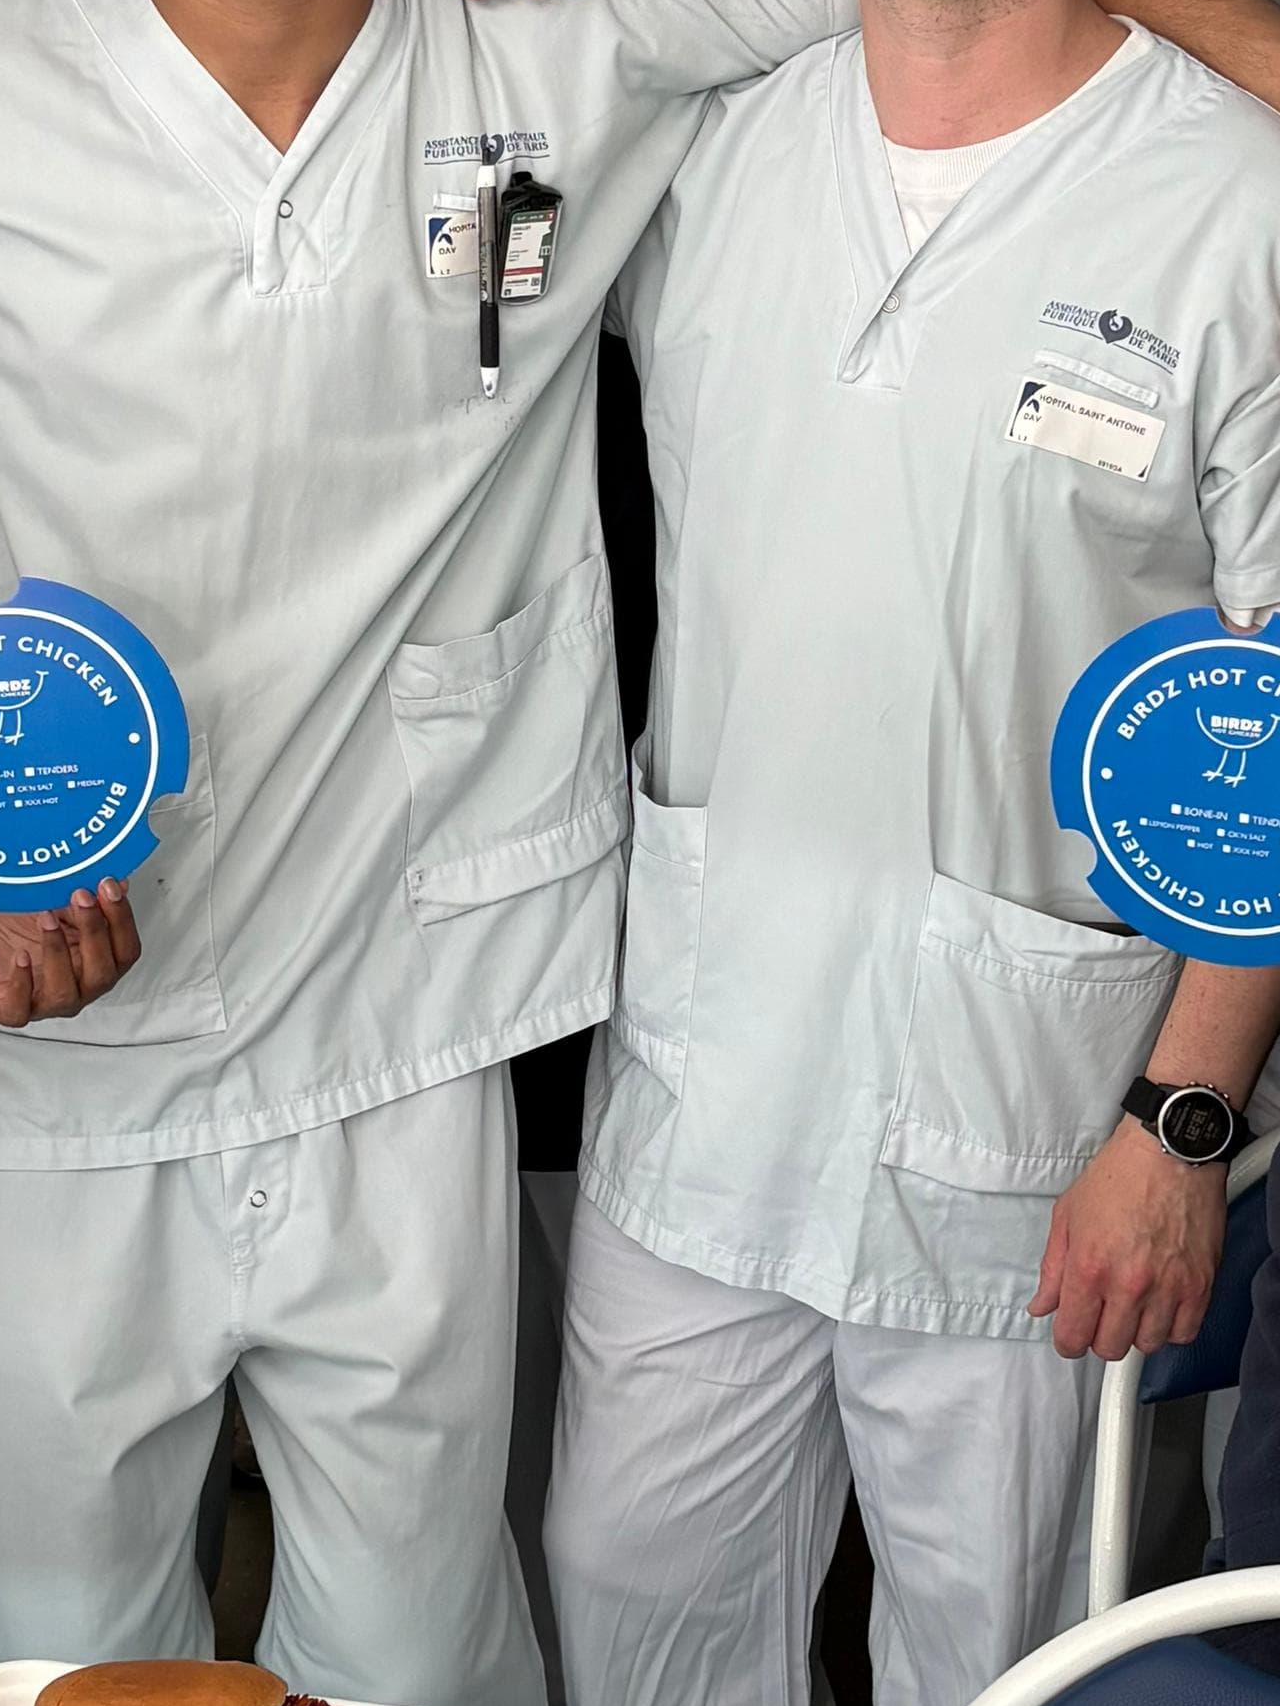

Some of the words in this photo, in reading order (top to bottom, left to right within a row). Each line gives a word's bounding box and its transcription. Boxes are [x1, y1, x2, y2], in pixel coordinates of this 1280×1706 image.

[1128, 336, 1145, 350] DE
[1148, 344, 1178, 368] PARIS
[1040, 394, 1076, 413] HOPITAL
[17, 636, 119, 707] CHICKEN
[1117, 679, 1182, 741] BIRDZ
[1187, 667, 1247, 690] HOT
[1211, 715, 1264, 732] BIRDZ
[37, 764, 79, 775] TENDERS
[74, 781, 128, 846] BIRDZ
[1183, 806, 1228, 821] BONE-IN
[18, 838, 71, 866] HOT
[1111, 818, 1207, 908] CHICKEN
[1215, 896, 1272, 916] HOT
